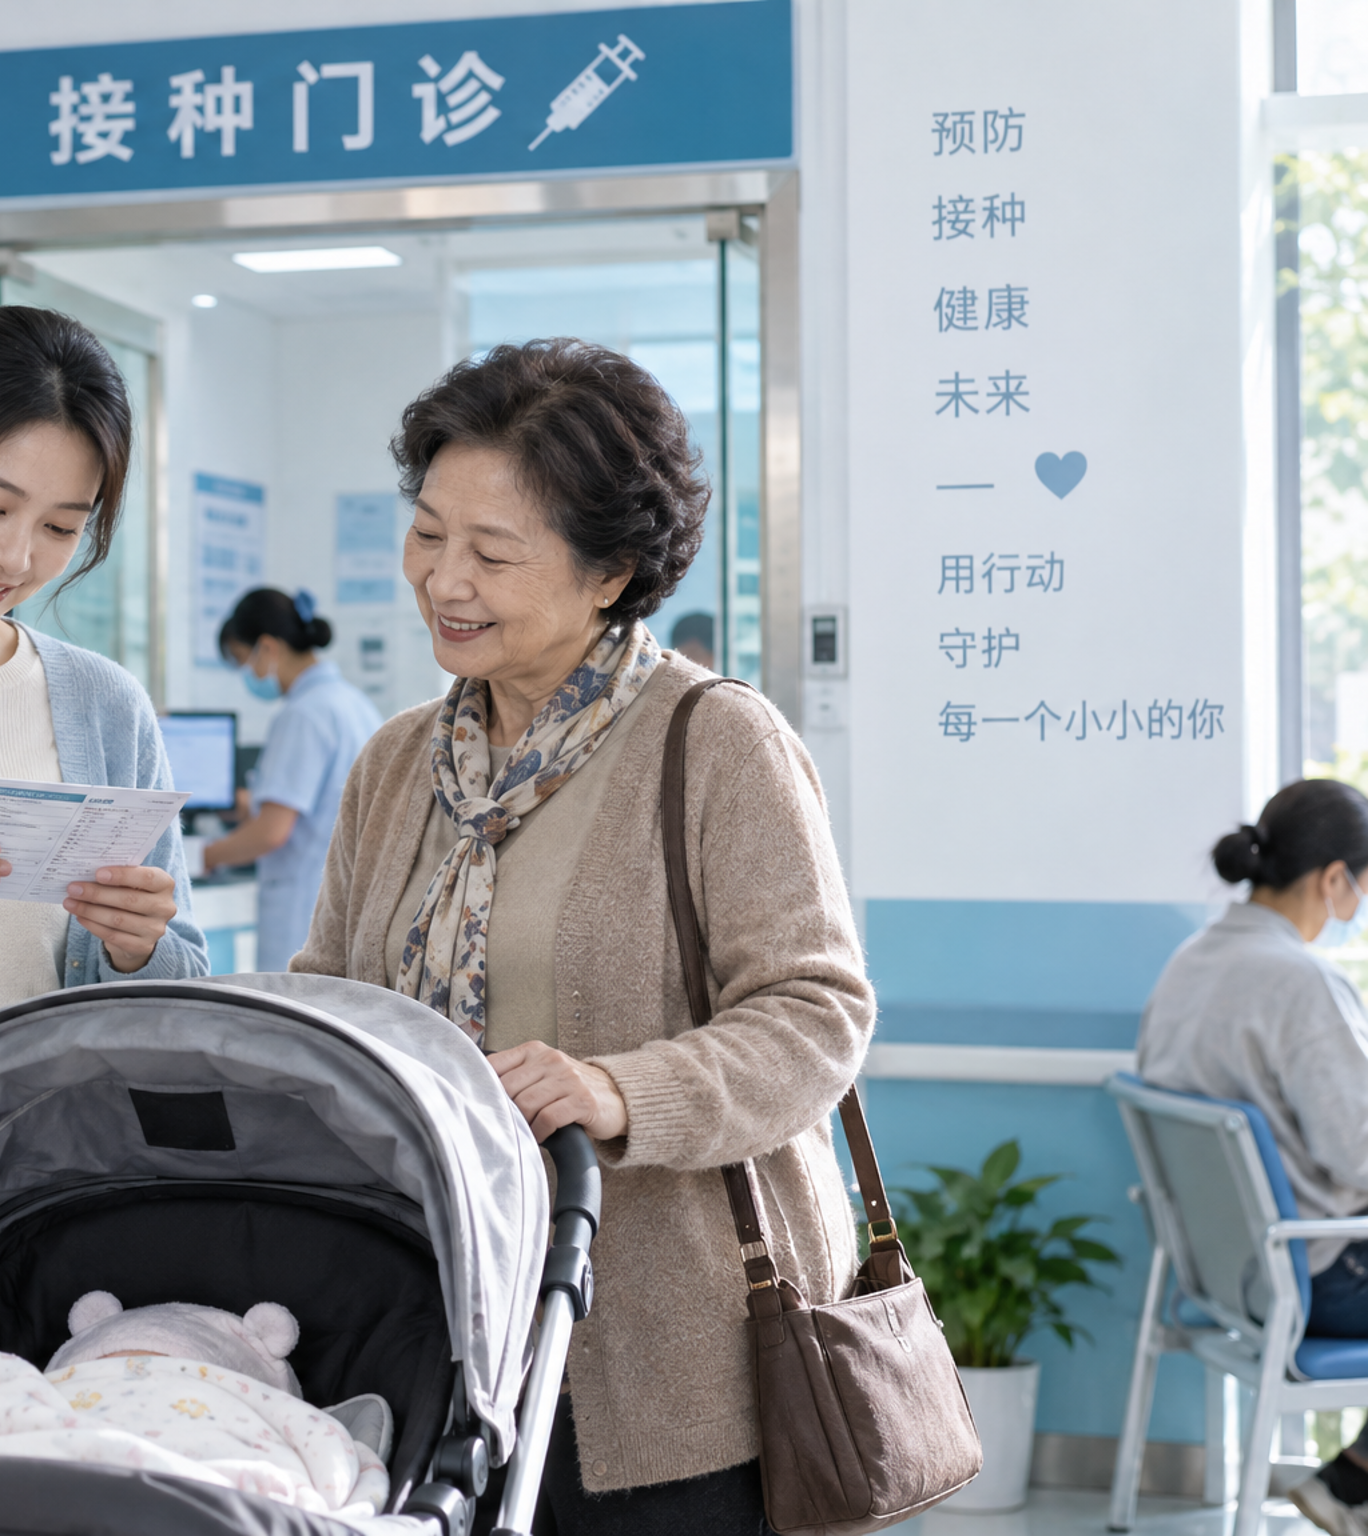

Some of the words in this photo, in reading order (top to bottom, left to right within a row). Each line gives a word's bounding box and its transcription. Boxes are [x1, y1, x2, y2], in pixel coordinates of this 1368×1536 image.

[48, 50, 505, 166] 接种门诊
[930, 106, 1027, 157] 预防
[931, 191, 1026, 242] 接种
[933, 283, 1030, 333] 健康
[934, 368, 1031, 419] 未来
[937, 550, 1065, 595] 用行动
[938, 626, 1021, 669] 守护
[938, 698, 1226, 743] 每一个小小的你
